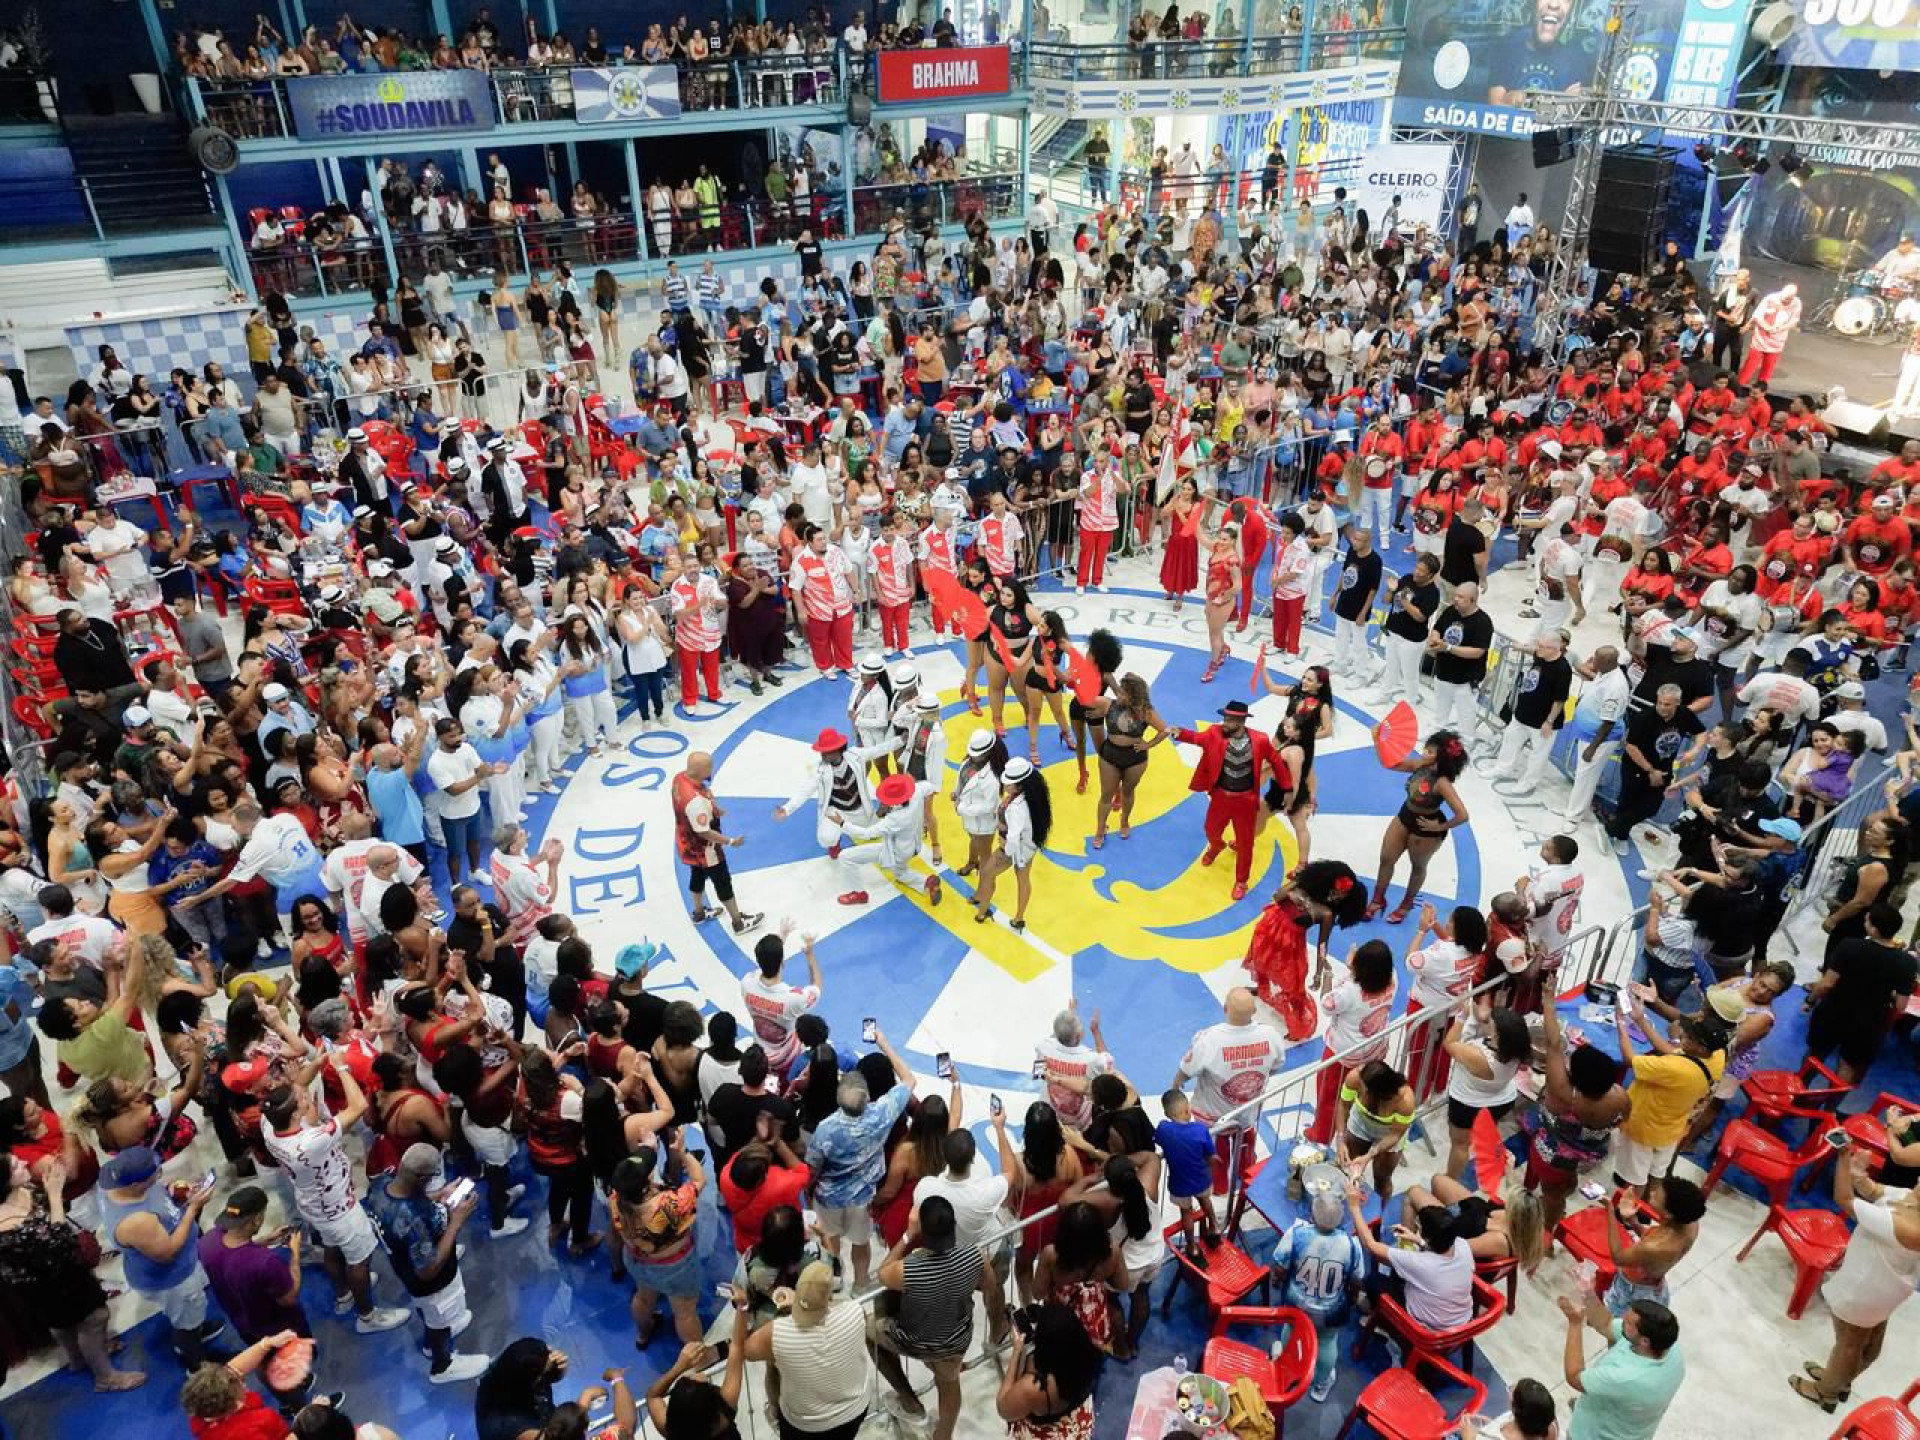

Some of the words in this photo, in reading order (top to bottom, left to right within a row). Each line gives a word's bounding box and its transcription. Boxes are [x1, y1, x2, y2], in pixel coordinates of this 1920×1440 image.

[912, 60, 979, 89] BRAHMA
[316, 98, 476, 133] #SOUDAVILA
[1423, 104, 1478, 129] SAÍDA
[1482, 113, 1507, 132] DE
[1368, 173, 1438, 187] CELEIRO
[568, 822, 647, 916] DE
[1295, 1256, 1344, 1300] 40
